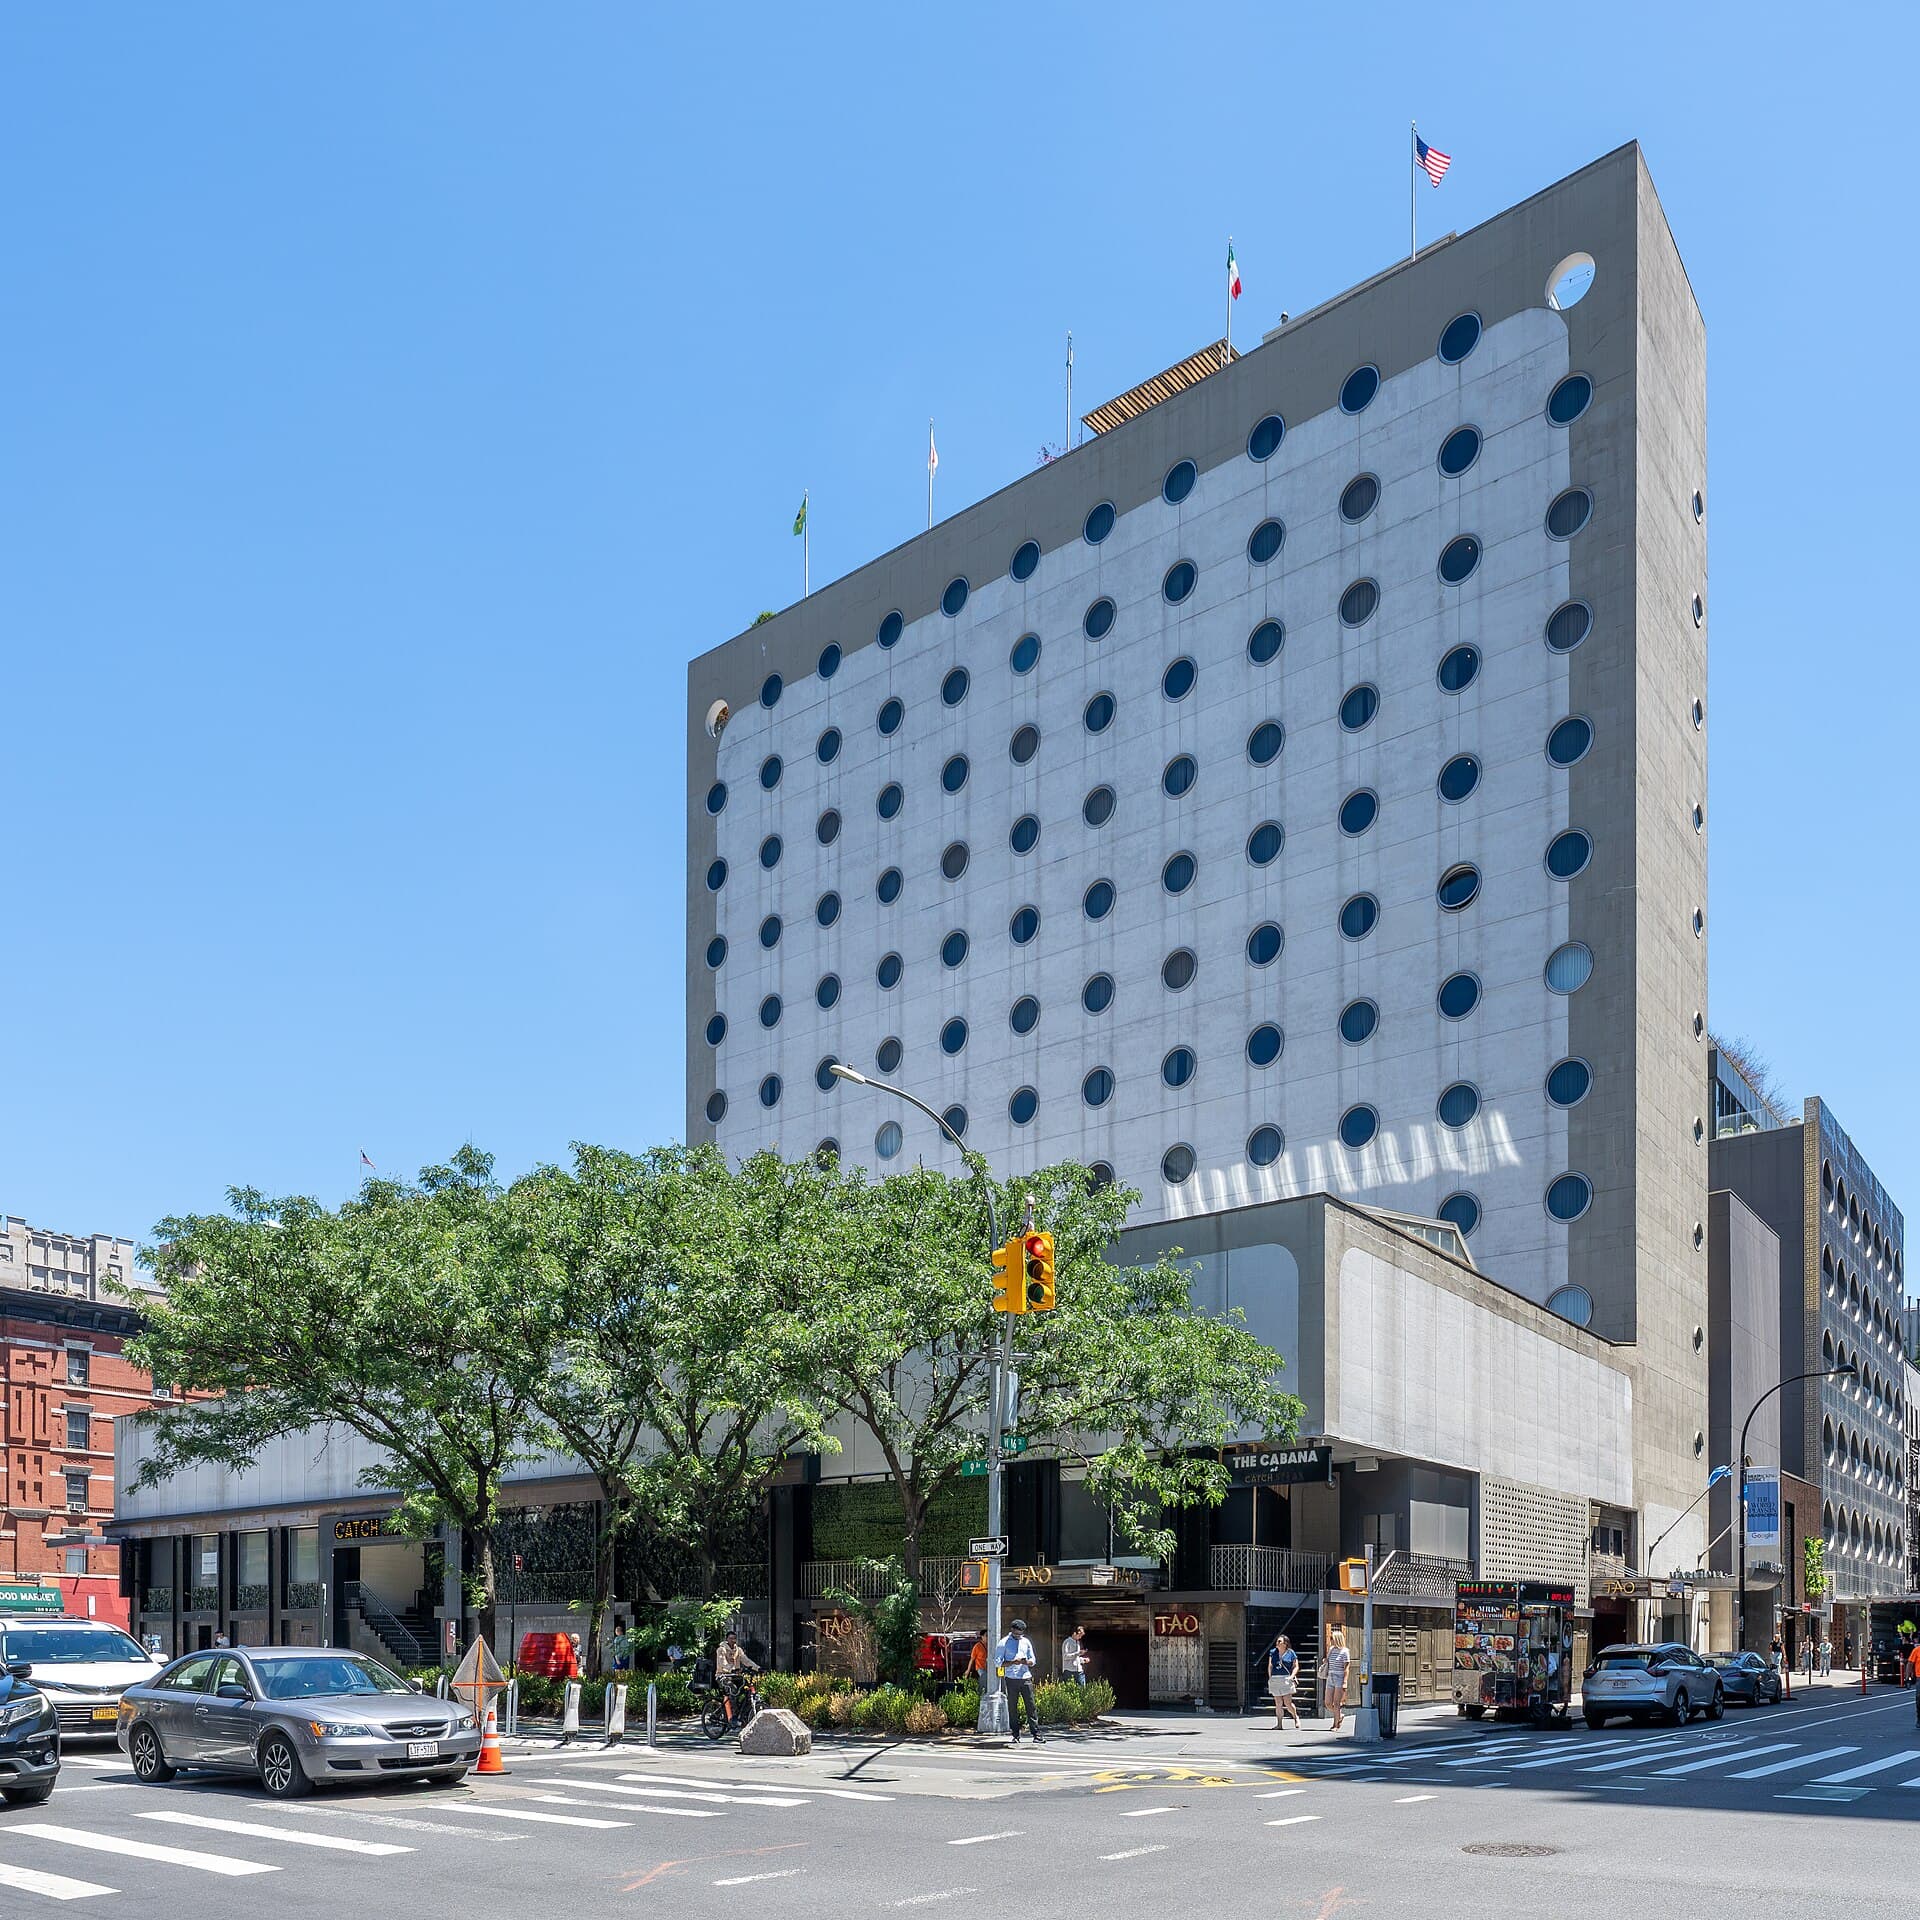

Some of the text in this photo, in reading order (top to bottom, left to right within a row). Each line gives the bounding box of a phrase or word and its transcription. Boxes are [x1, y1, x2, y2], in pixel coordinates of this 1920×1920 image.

[1233, 1450, 1319, 1469] THE CABANA
[1244, 1473, 1273, 1483] CATCH
[335, 1519, 379, 1540] CATCH
[1751, 1532, 1774, 1540] Google
[990, 1542, 1001, 1550] WAY
[1013, 1565, 1053, 1585] TAO
[1112, 1567, 1142, 1585] TAO
[1603, 1580, 1636, 1595] TAO
[20, 1592, 57, 1602] MARKET
[820, 1616, 852, 1636] TAO
[1154, 1613, 1199, 1635] TAO
